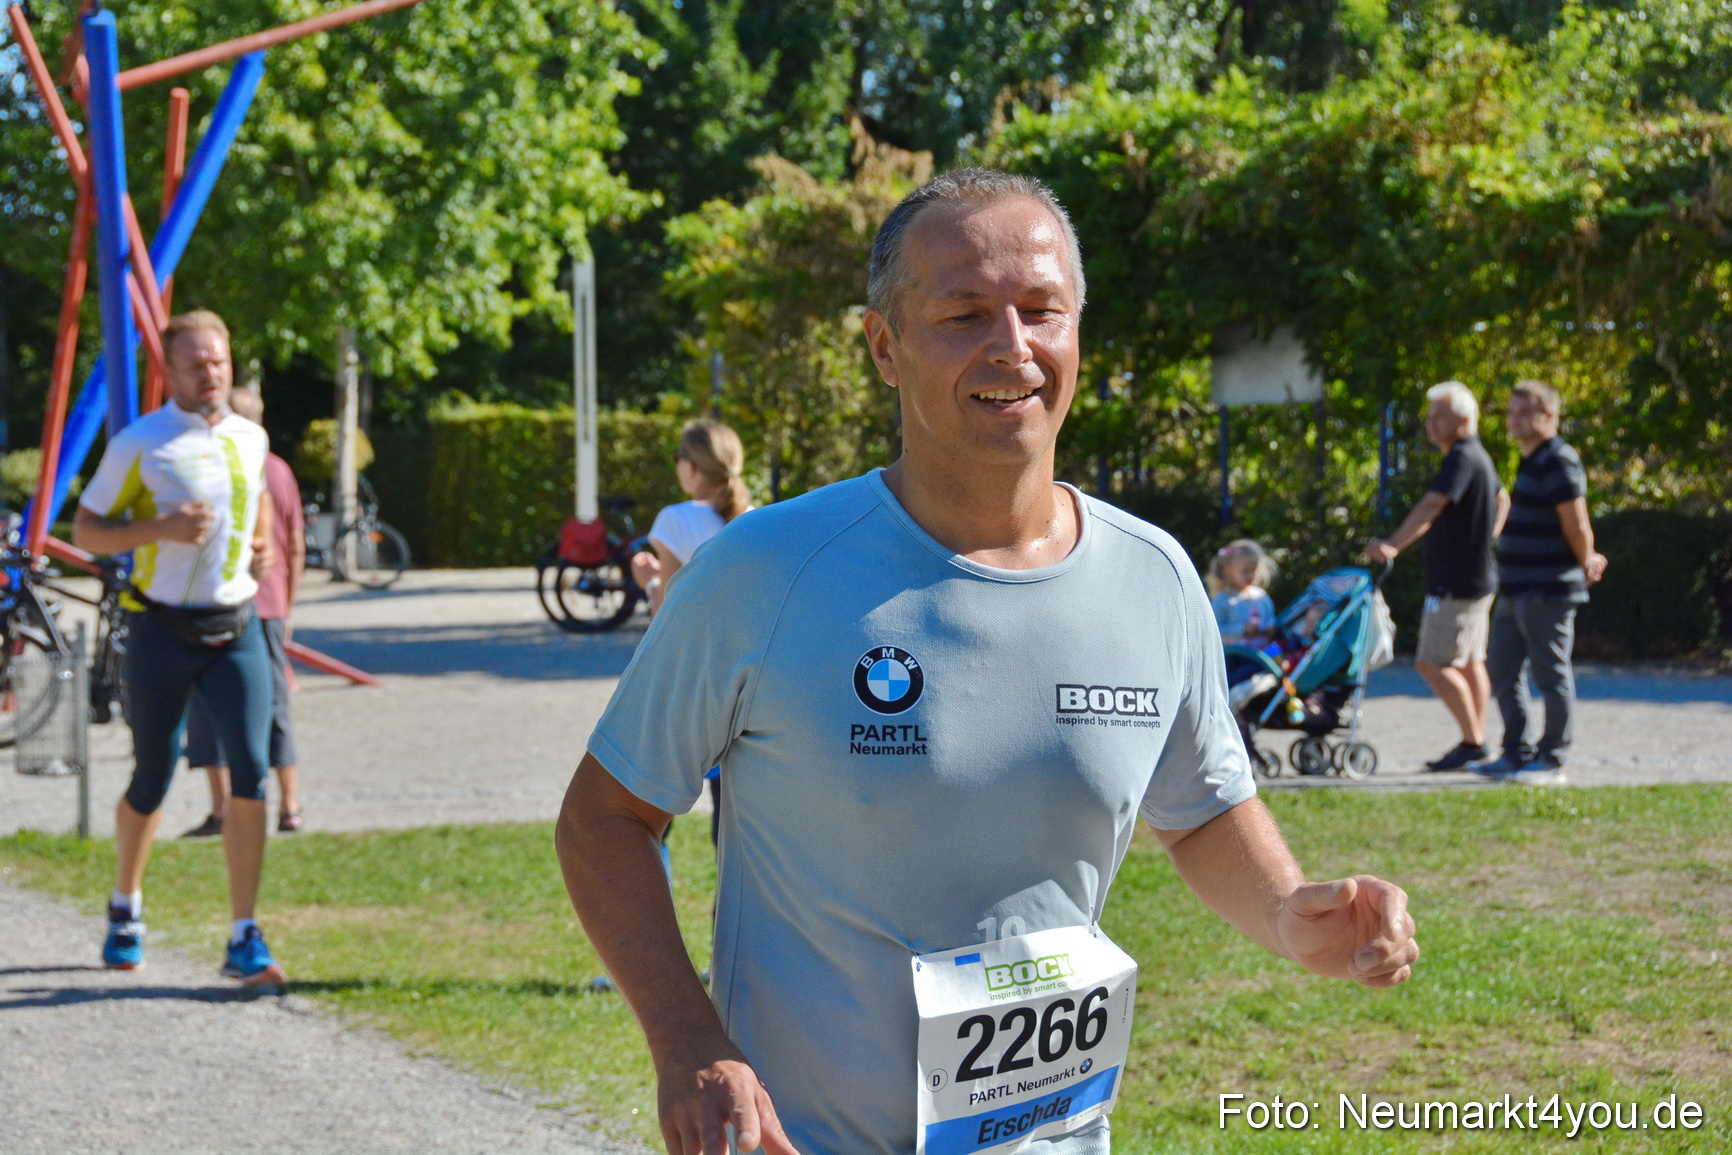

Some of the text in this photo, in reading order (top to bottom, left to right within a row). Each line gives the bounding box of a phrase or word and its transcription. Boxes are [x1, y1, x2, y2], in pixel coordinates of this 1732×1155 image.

[860, 647, 918, 670] BMW
[1056, 684, 1160, 717] BOCK
[850, 724, 928, 742] PARTL
[1056, 715, 1161, 730] inspired by smart concepts
[850, 741, 928, 756] Neumarkt
[985, 953, 1075, 992] BOCK
[989, 982, 1056, 1001] inspired by smart
[955, 986, 1109, 1083] 2266
[969, 1087, 1014, 1106] PARTL
[1016, 1066, 1076, 1094] Neumarkt
[977, 1096, 1073, 1145] Erschda
